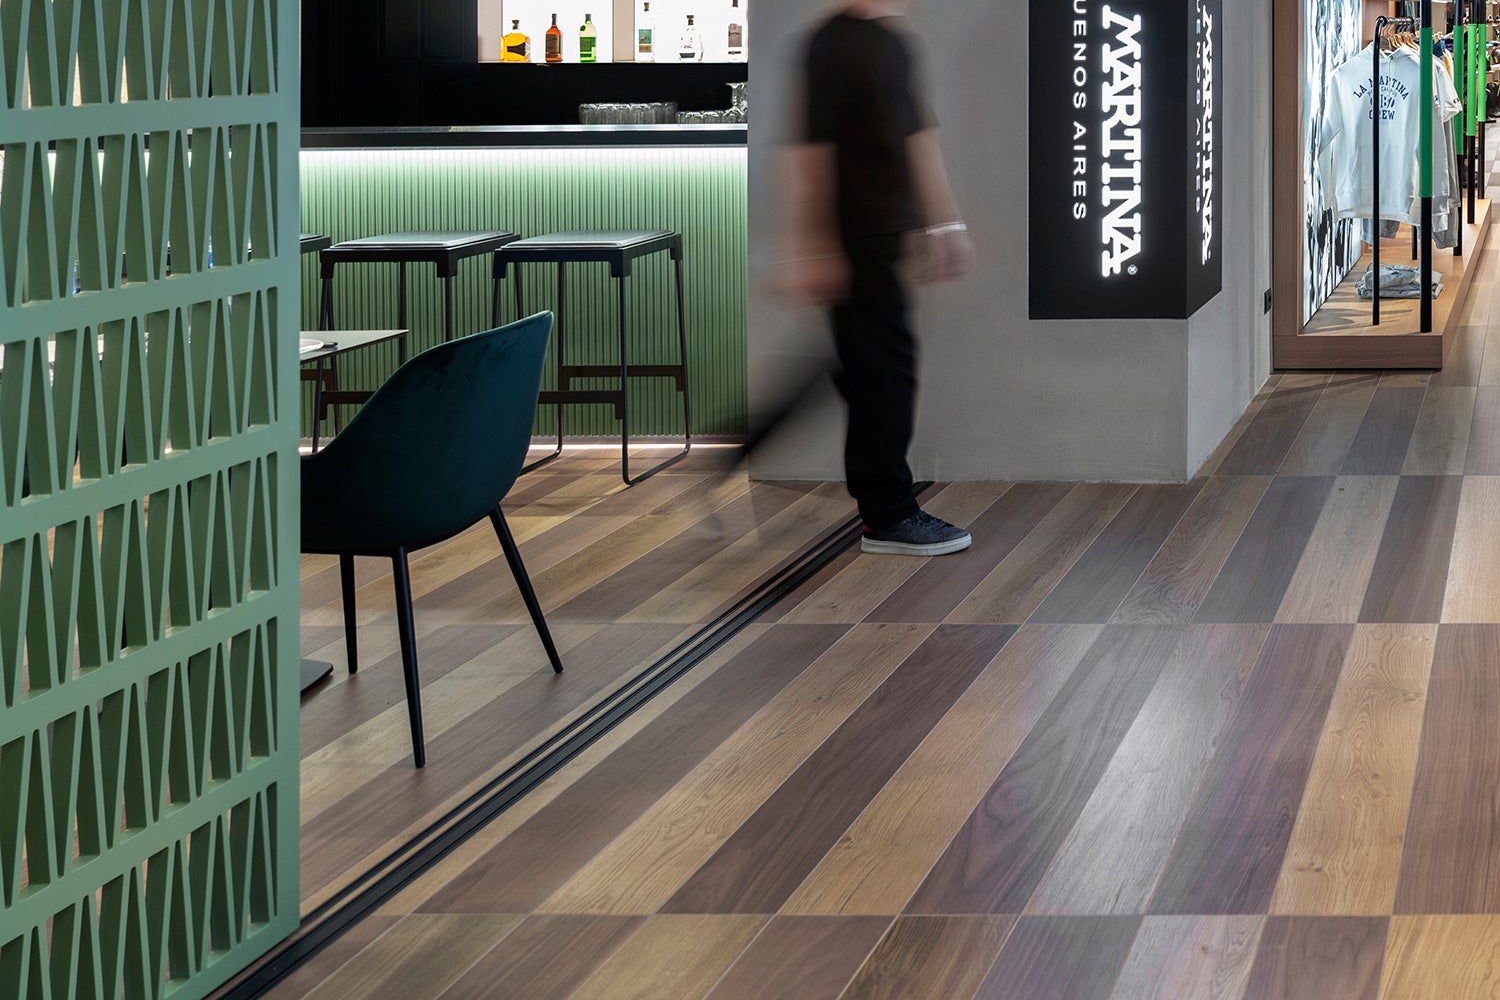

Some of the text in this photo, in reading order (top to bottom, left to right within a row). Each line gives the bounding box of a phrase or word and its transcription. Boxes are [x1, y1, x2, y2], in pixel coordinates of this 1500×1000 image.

[1073, 121, 1087, 220] AIRES
[1102, 5, 1142, 277] MARTINA
[1203, 4, 1212, 265] MARTINA
[1369, 109, 1395, 121] CEW
